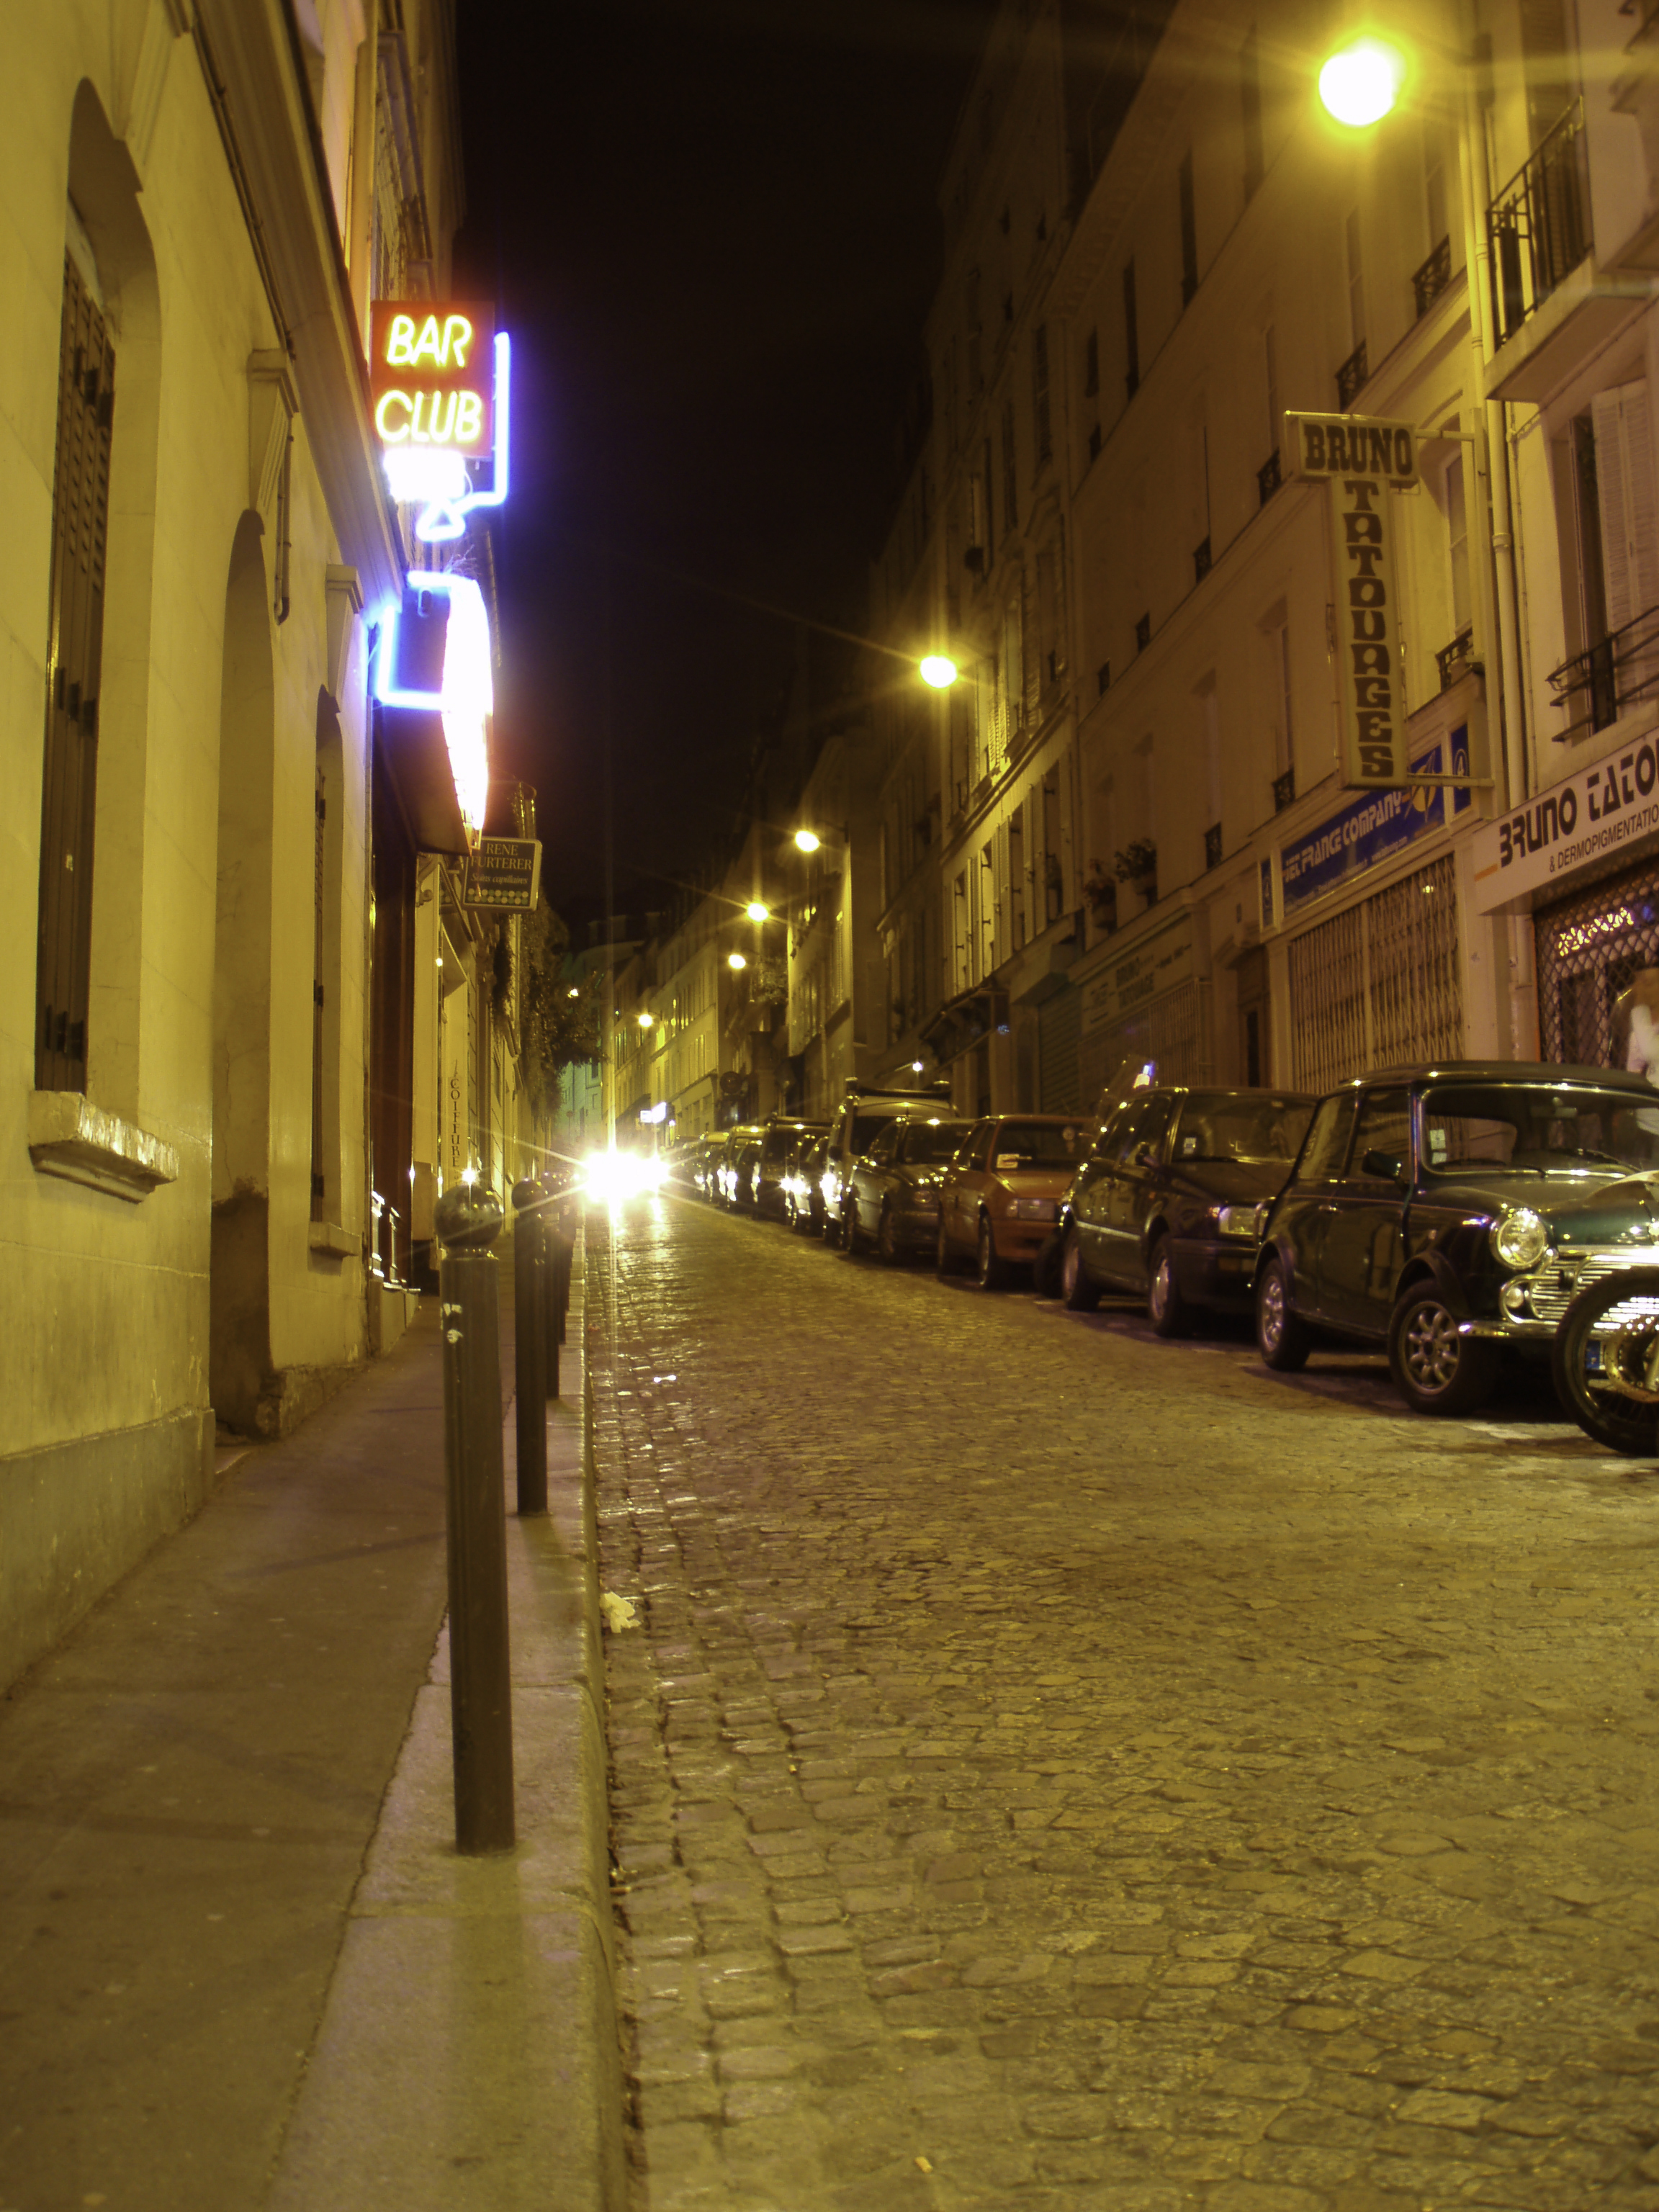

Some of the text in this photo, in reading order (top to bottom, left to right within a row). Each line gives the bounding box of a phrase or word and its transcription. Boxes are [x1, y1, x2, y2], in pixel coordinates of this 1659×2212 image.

[387, 315, 472, 368] BAR
[374, 390, 482, 444] CLUB
[1303, 423, 1413, 476] BRUNO
[1343, 480, 1394, 778] TATOUAGES
[1342, 791, 1402, 847] COMPANY
[1499, 738, 1659, 868] BRUNO TATO
[471, 855, 532, 871] FURTERER
[486, 842, 518, 856] RENE
[1549, 855, 1556, 873] &
[450, 1078, 461, 1168] COIFFURE
